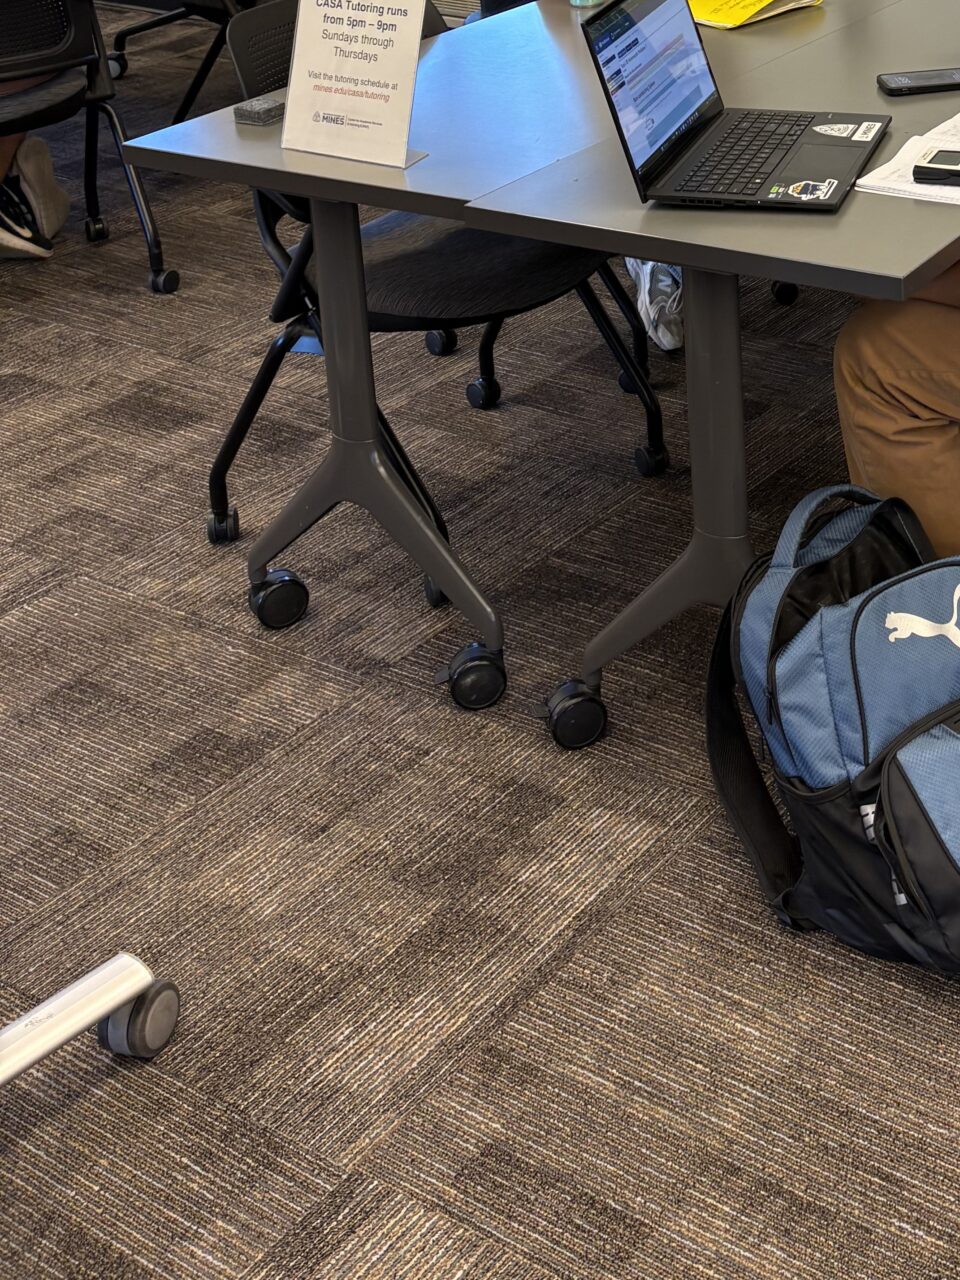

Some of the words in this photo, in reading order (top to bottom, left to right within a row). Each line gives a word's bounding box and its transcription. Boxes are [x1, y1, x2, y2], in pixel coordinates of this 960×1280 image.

[346, 0, 385, 16] Tutoring
[386, 7, 408, 16] runs
[322, 13, 344, 26] from
[346, 16, 366, 29] 5pm
[376, 20, 397, 32] 9pm
[321, 29, 359, 45] Sundays
[361, 34, 394, 49] through
[334, 46, 378, 63] Thursdays
[308, 70, 322, 79] Visit
[322, 73, 333, 81] the
[334, 75, 359, 87] tutoring
[360, 78, 390, 89] schedule
[391, 82, 398, 91] at
[322, 116, 345, 126] MINES
